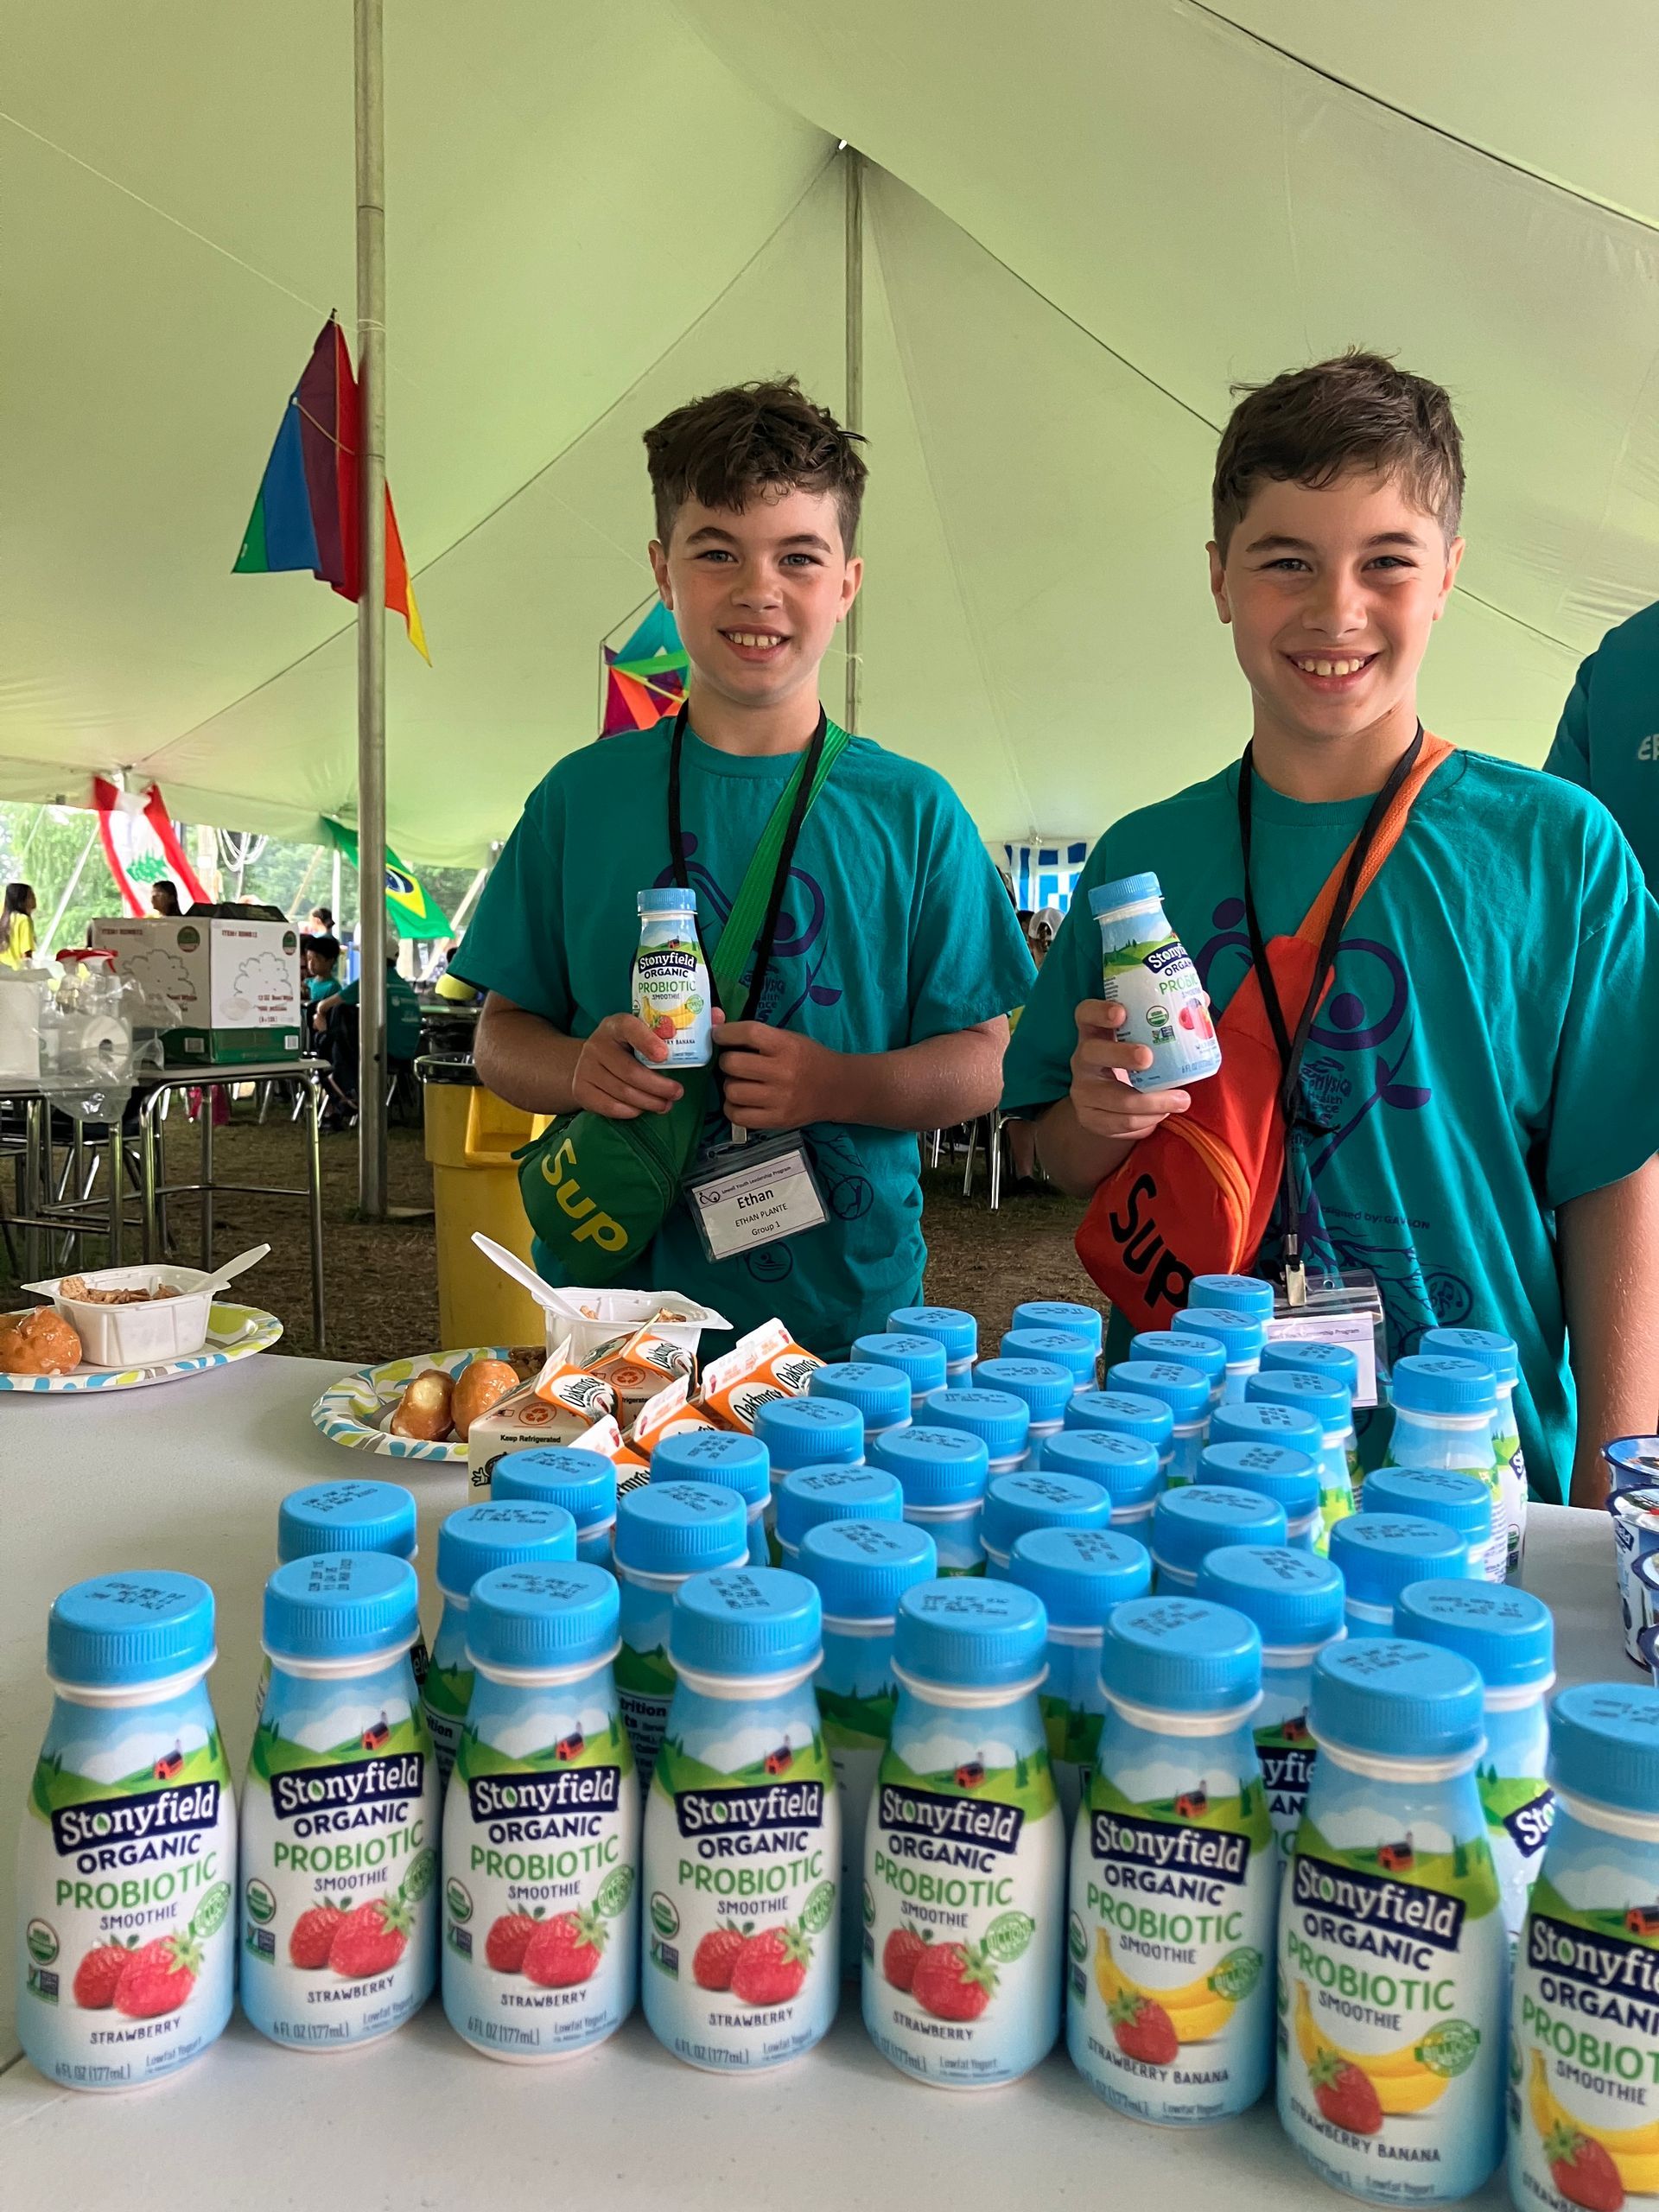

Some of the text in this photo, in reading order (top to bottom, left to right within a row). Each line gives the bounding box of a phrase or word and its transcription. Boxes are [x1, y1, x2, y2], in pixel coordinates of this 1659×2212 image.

[639, 951, 696, 970] Stonyfield
[644, 967, 690, 979] ORGANIC
[639, 981, 696, 994] PROBIOTIC
[541, 1138, 629, 1251] Sup
[737, 1189, 774, 1210] Ethan
[735, 1203, 789, 1228] ETHAN PLANTE
[751, 1224, 775, 1236] Group
[1109, 1173, 1195, 1308] Sup
[776, 1359, 821, 1389] Oakhurst
[518, 1434, 562, 1443] Refrigerated
[278, 1757, 419, 1811] Stonyfield
[475, 1772, 615, 1816] Stonyfield
[59, 1786, 216, 1847] Stonyfield
[294, 1802, 410, 1838] ORGANIC
[683, 1786, 819, 1830] Stonyfield
[882, 1789, 1017, 1843] Stonyfield
[272, 1819, 423, 1873] PROBIOTIC
[487, 1816, 604, 1845] ORGANIC
[697, 1831, 810, 1859] ORGANIC
[1096, 1816, 1245, 1872] Stonyfield
[76, 1834, 201, 1876] ORGANIC
[470, 1835, 620, 1881] PROBIOTIC
[677, 1849, 823, 1897] PROBIOTIC
[888, 1834, 995, 1873] ORGANIC
[56, 1850, 218, 1911] PROBIOTIC
[315, 1866, 389, 1892] SMOOTHIE
[508, 1880, 581, 1901] SMOOTHIE
[874, 1850, 1014, 1908] PROBIOTIC
[1104, 1865, 1226, 1908] ORGANIC
[1297, 1859, 1458, 1938] Stonyfield
[100, 1905, 178, 1931] SMOOTHIE
[717, 1896, 789, 1916] SMOOTHIE
[901, 1900, 969, 1928] SMOOTHIE
[1087, 1883, 1243, 1944] PROBIOTIC
[1119, 1935, 1196, 1964] SMOOTHIE
[1304, 1913, 1435, 1971] ORGANIC
[307, 1975, 395, 2004] STRAWBERRY
[1287, 1930, 1455, 2012] PROBIOTIC
[501, 1989, 588, 2008] STRAWBERRY
[709, 2007, 794, 2027] STRAWBERRY
[1319, 1990, 1402, 2031] SMOOTHIE
[1540, 1978, 1659, 2035] ORGANI
[90, 2017, 181, 2044] STRAWBERRY
[893, 2011, 973, 2040] STRAWBERRY
[1522, 1995, 1659, 2082] PROBIOT
[1087, 2037, 1229, 2085] STRAWBERRY BANANA
[1557, 2060, 1647, 2107] SMOOTHIE
[1377, 2144, 1441, 2162] BANANA
